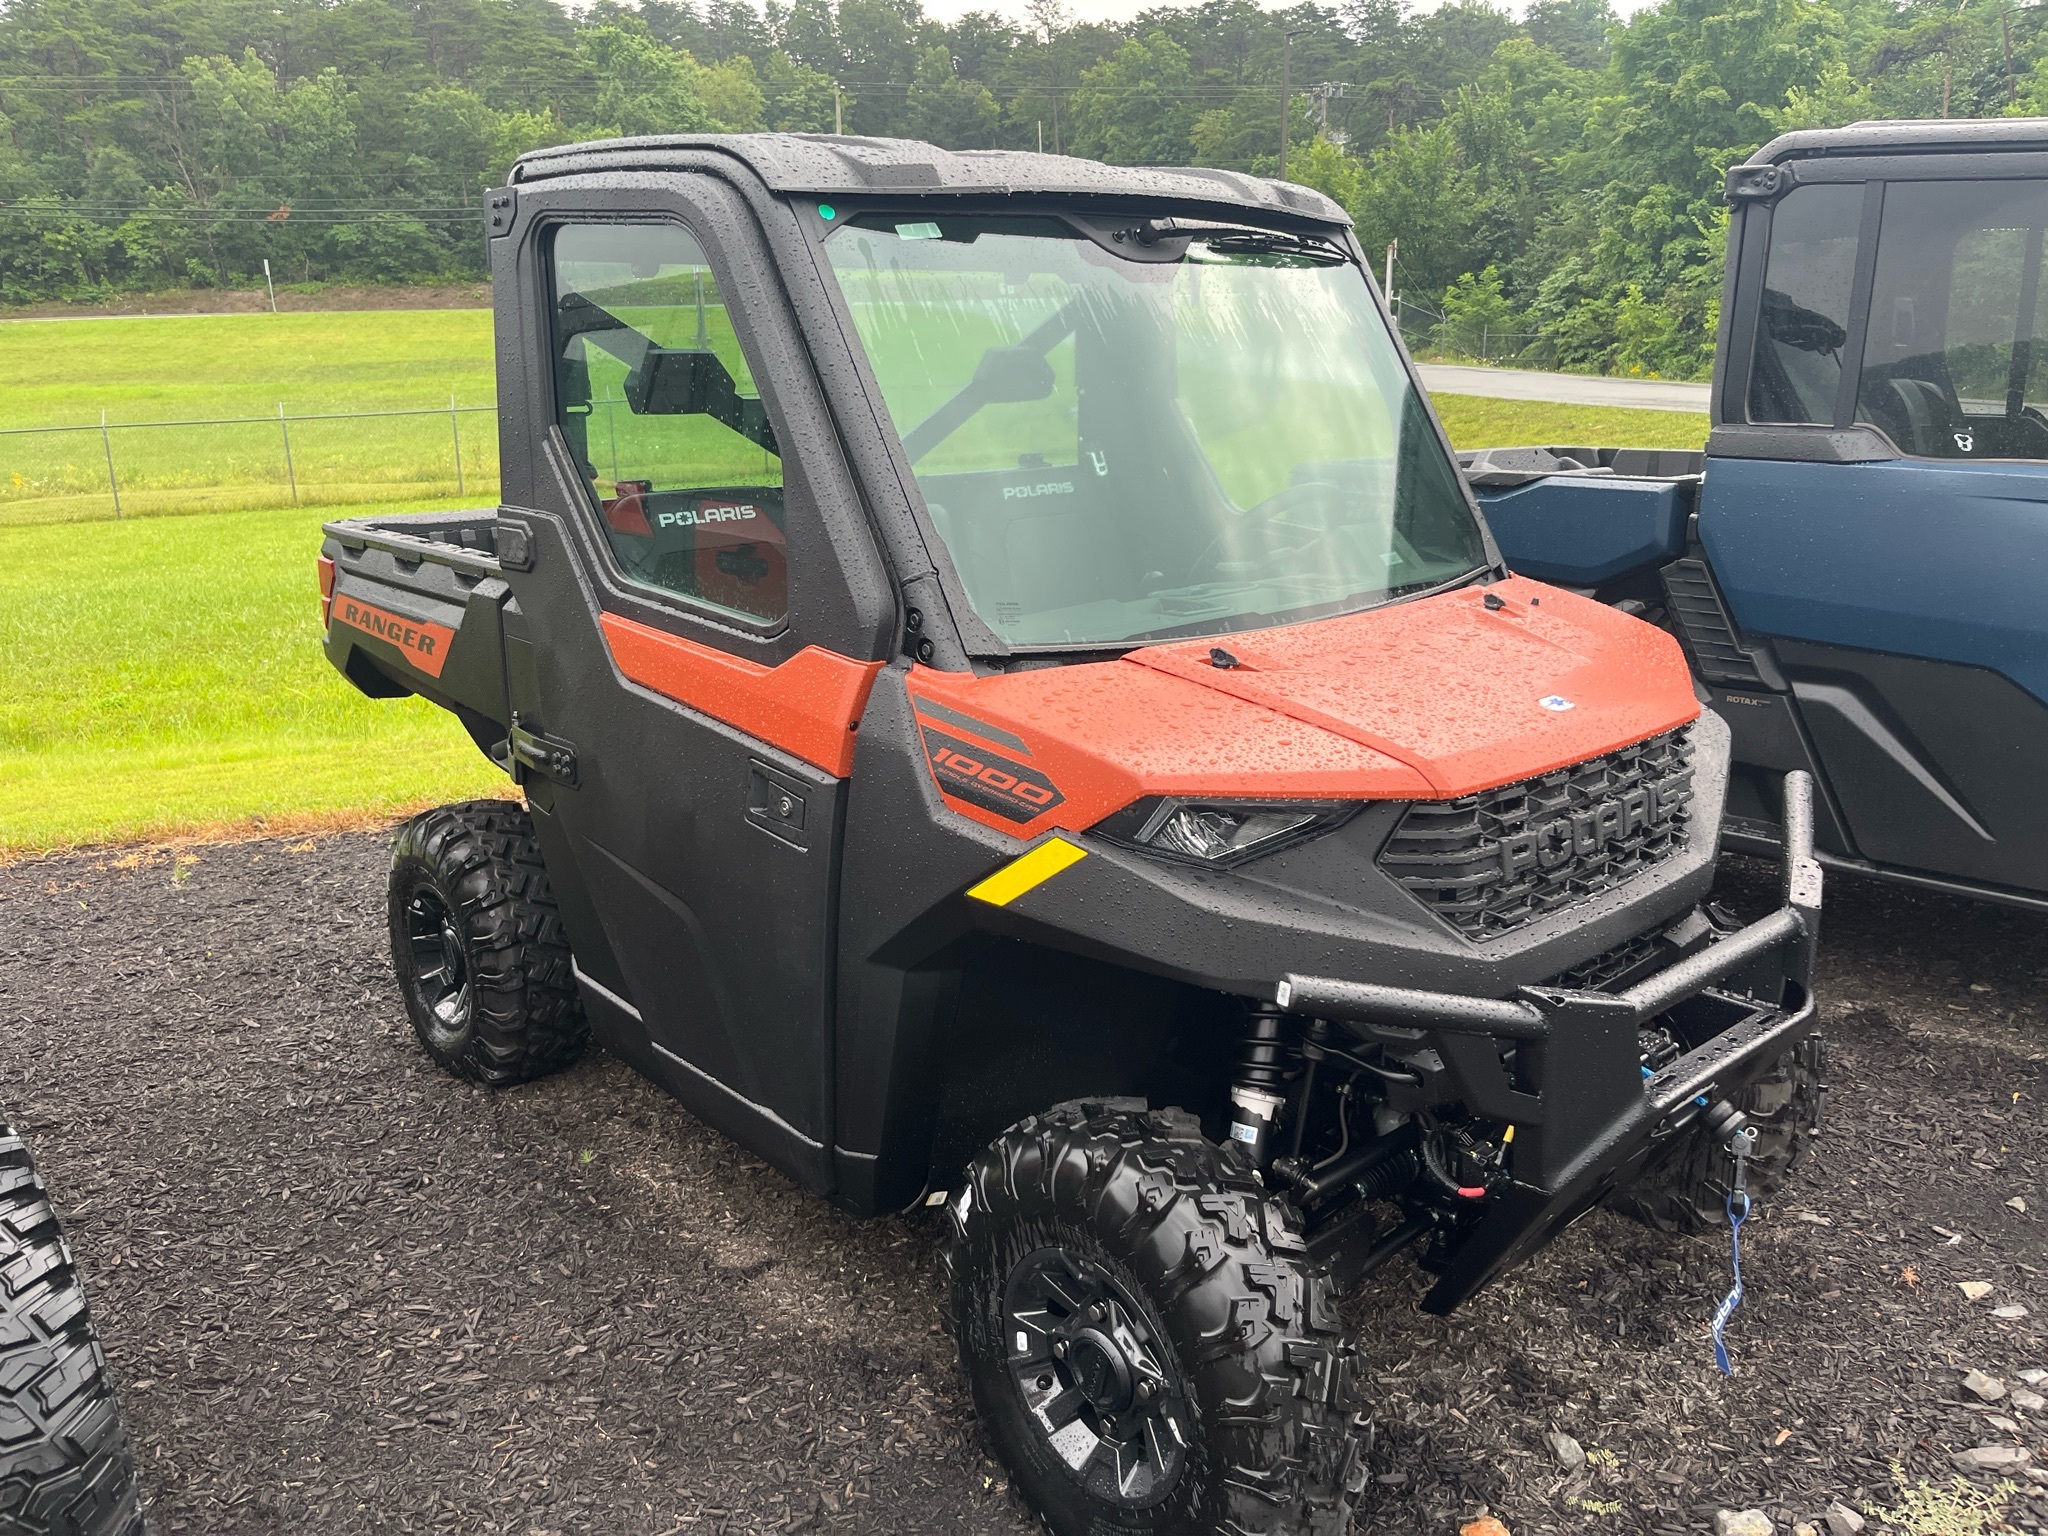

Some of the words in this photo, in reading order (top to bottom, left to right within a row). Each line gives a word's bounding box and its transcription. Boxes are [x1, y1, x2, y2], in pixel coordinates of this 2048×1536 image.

[1003, 481, 1074, 500] POLARIS
[658, 505, 756, 528] POLARIS
[345, 603, 436, 655] RANGER
[1726, 695, 1758, 706] ROTAX
[933, 748, 1054, 805] 1000
[1500, 777, 1680, 883] POLARIS
